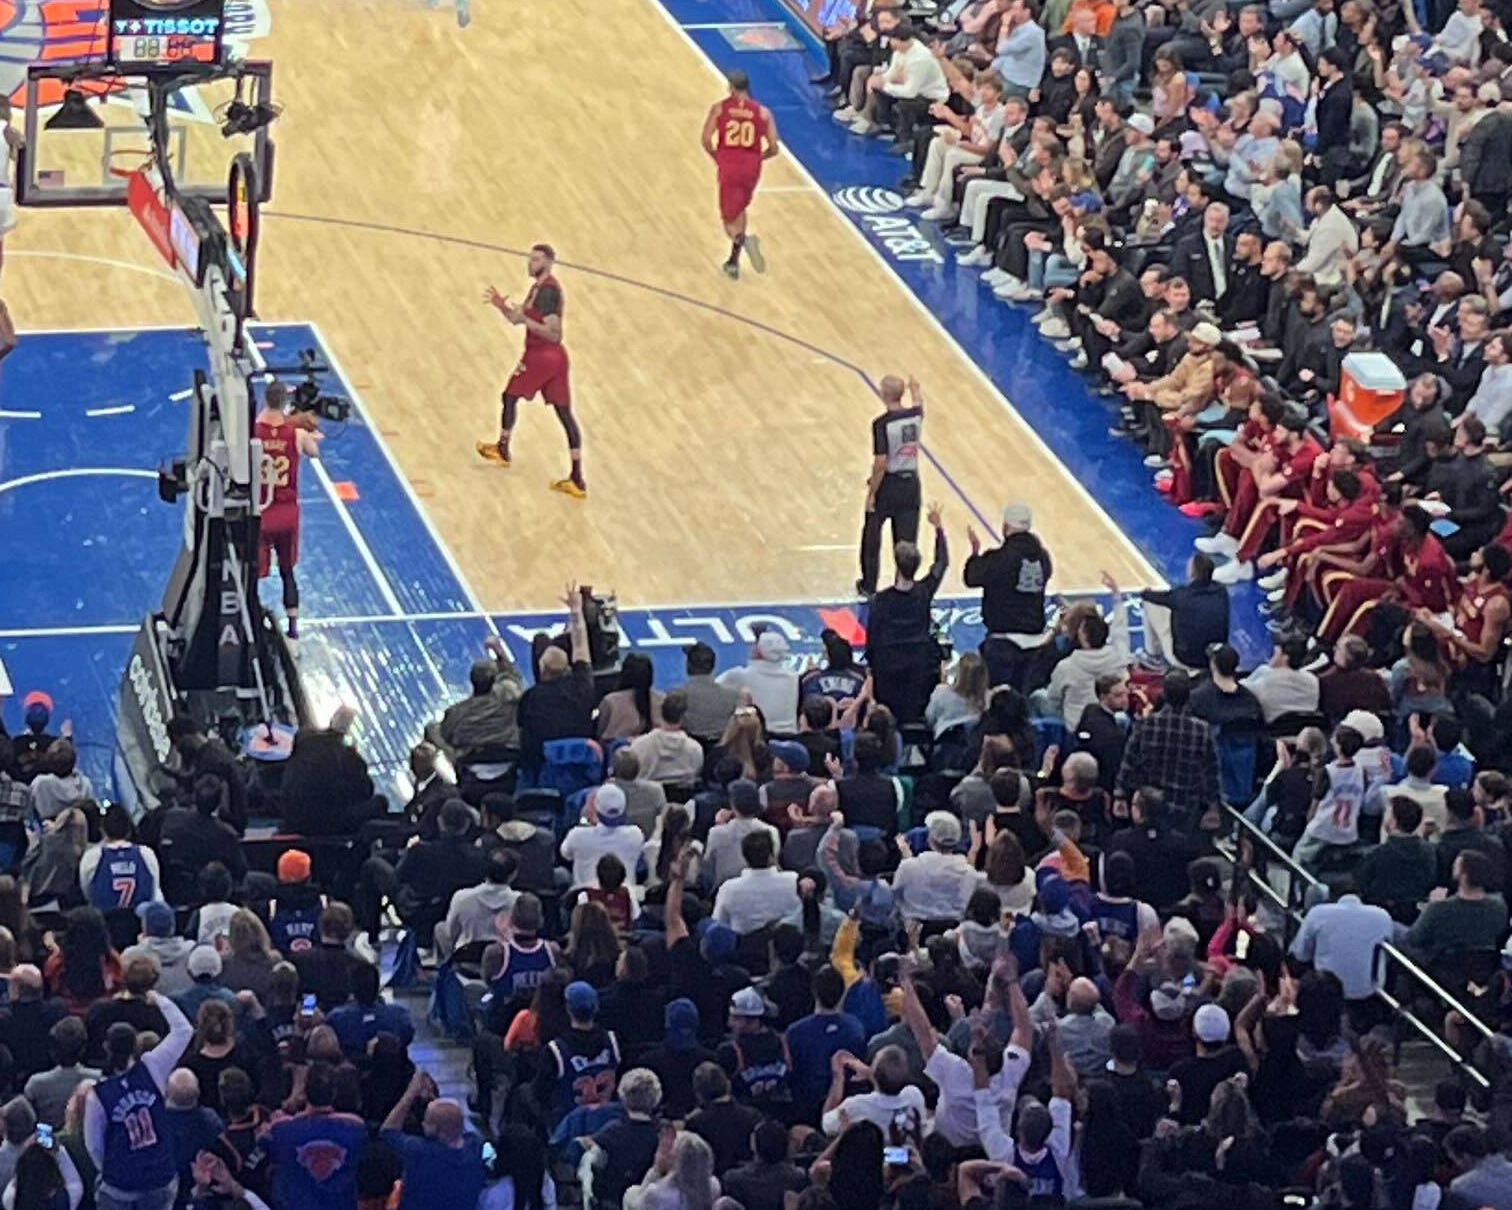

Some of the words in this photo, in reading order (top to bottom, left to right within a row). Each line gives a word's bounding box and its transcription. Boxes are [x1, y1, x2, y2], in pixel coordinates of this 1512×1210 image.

[146, 17, 220, 35] TISSOT
[724, 119, 756, 148] 20
[861, 214, 944, 265] AT&T
[112, 877, 137, 908] 7
